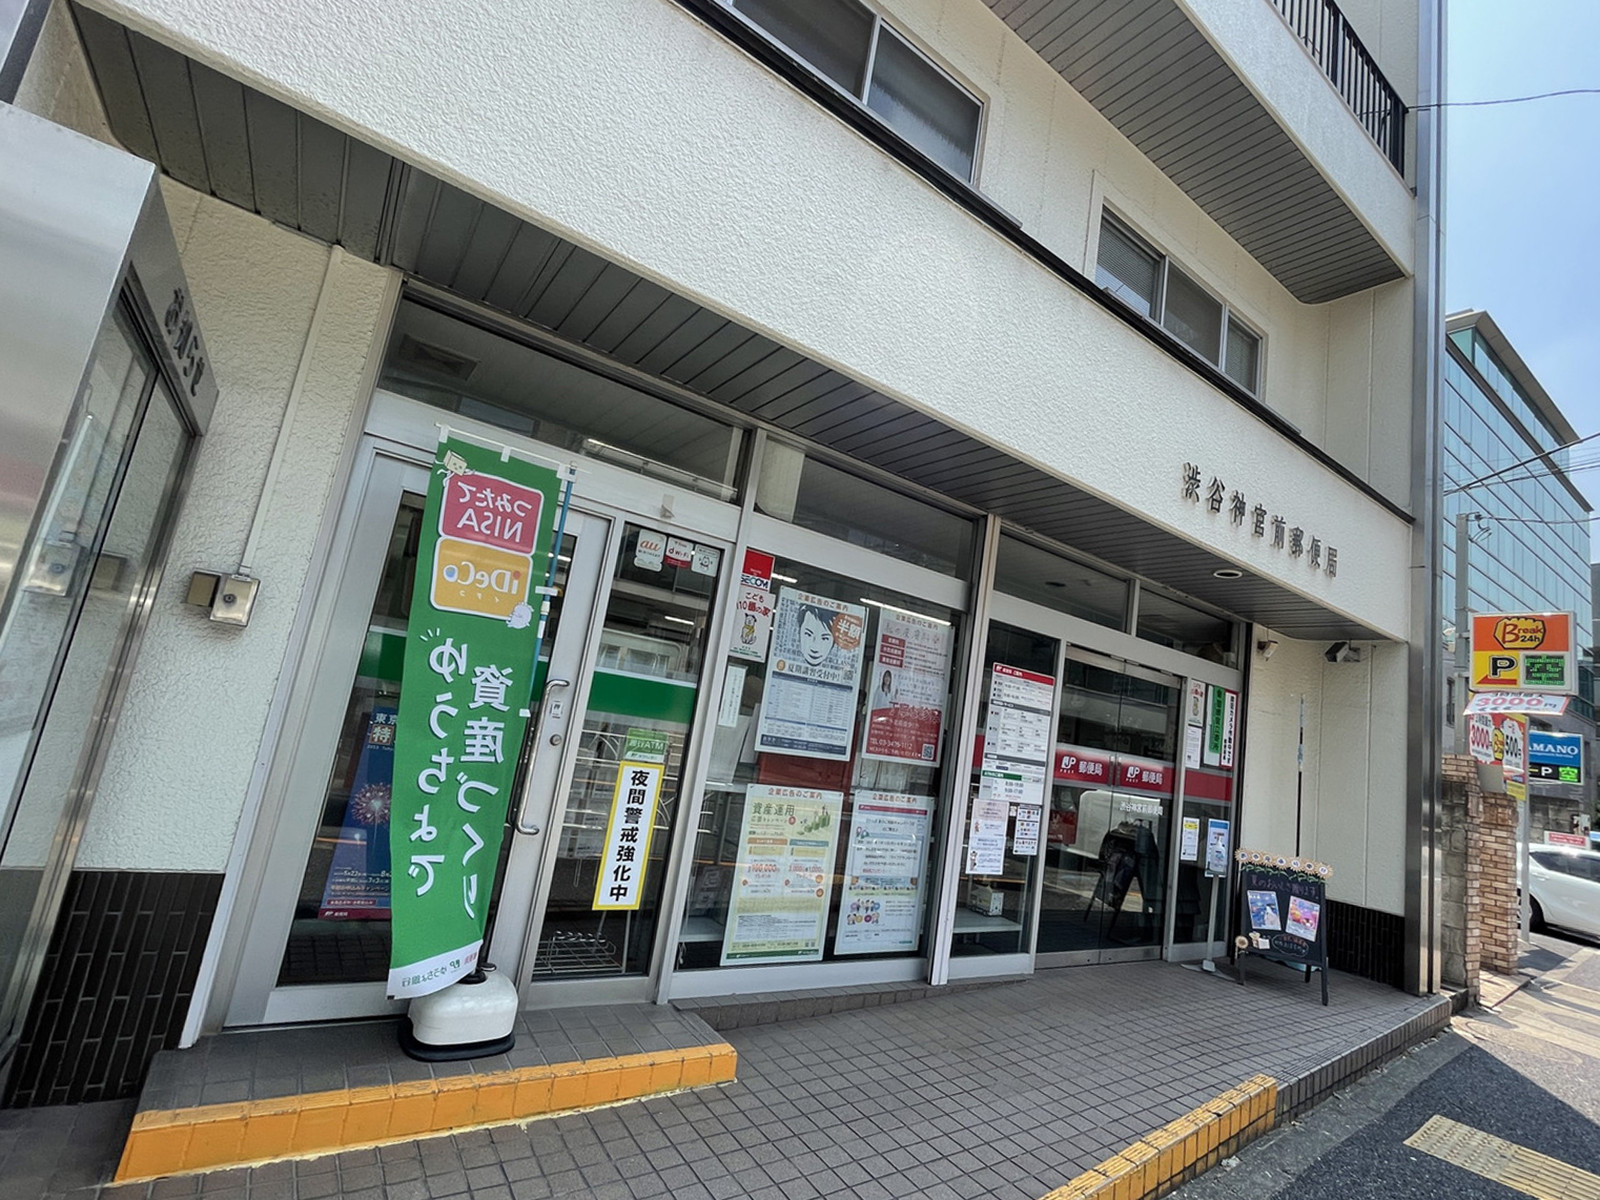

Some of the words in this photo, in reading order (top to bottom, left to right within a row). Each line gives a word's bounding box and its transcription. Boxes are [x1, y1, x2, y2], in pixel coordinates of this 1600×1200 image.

[1182, 462, 1338, 578] 渋谷神宮前郵便局
[740, 573, 769, 589] SECOM
[745, 592, 764, 603] こども
[1501, 621, 1544, 645] Break
[1519, 634, 1541, 643] 24h
[1490, 656, 1516, 677] P
[1079, 760, 1103, 776] 郵便局
[1541, 766, 1553, 776] P
[1142, 770, 1163, 785] 郵便局
[752, 802, 795, 817] 資産運用
[609, 769, 650, 902] 夜間警戒強化中
